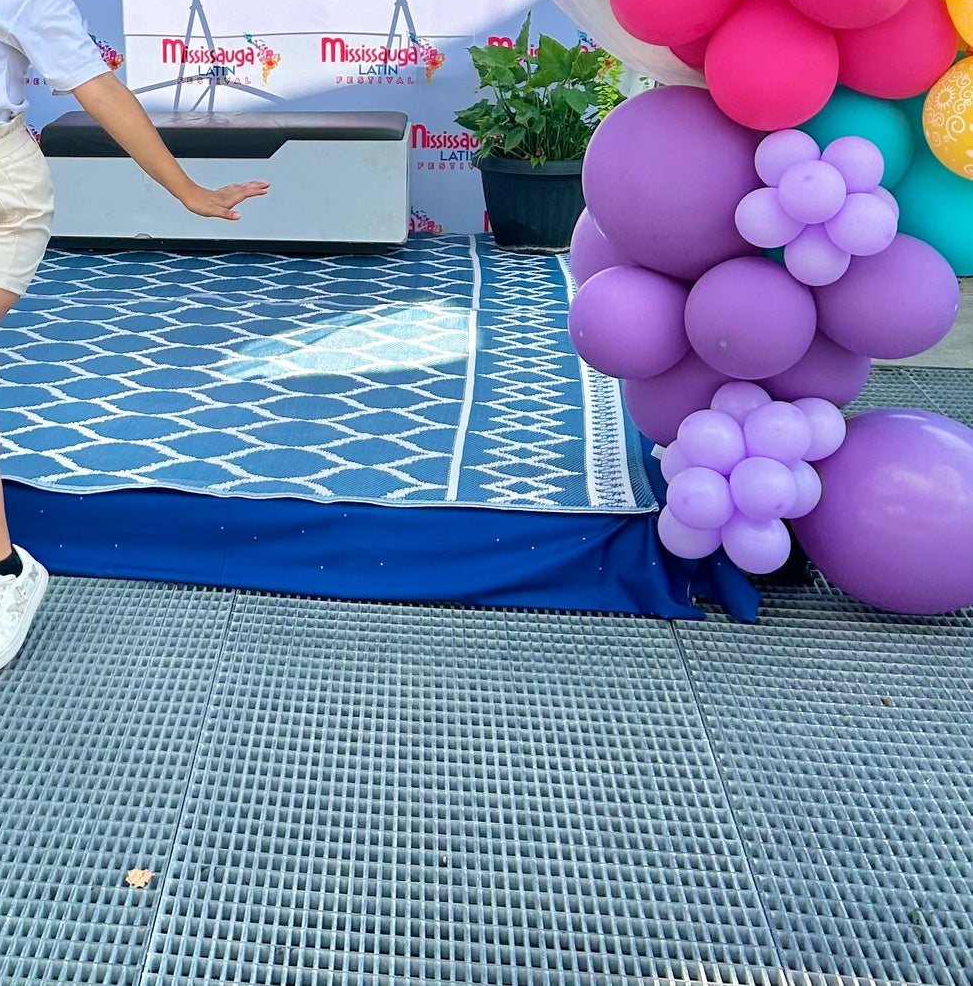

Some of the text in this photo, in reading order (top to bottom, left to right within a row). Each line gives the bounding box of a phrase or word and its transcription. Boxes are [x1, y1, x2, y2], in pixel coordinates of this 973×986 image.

[162, 38, 255, 67] Mississauga
[321, 37, 418, 67] Mississauga
[198, 65, 236, 76] LATIN
[358, 64, 398, 76] LATIN
[335, 76, 414, 85] FESTIVAL
